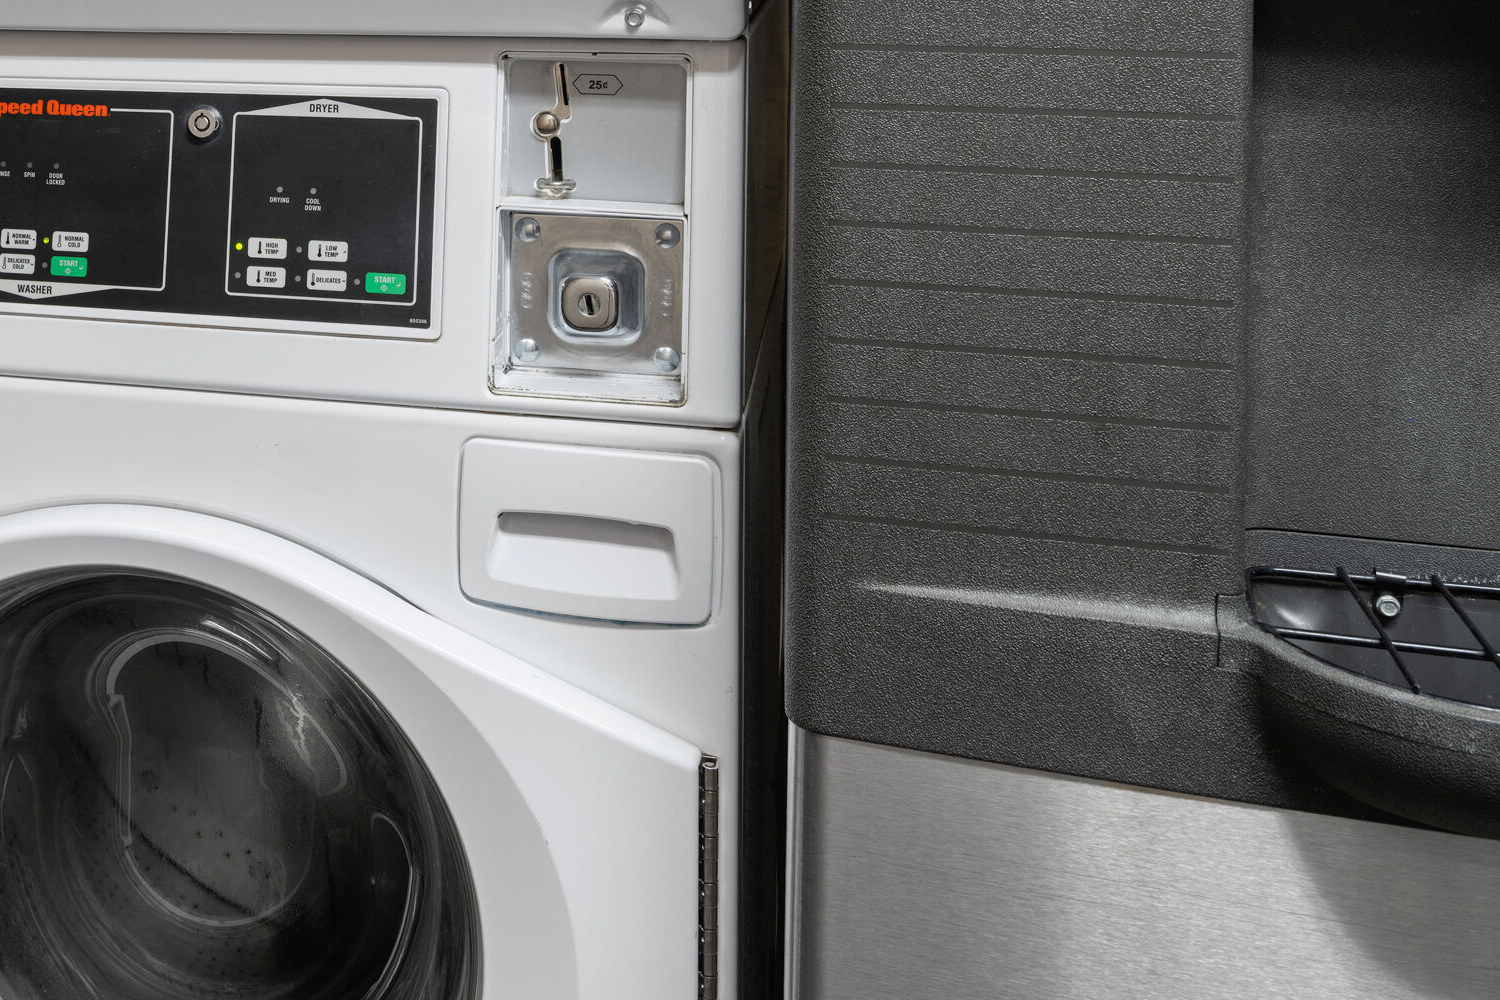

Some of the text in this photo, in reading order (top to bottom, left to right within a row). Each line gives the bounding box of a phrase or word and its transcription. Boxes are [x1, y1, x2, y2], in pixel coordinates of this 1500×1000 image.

[588, 80, 608, 90] 25¢
[46, 99, 108, 117] Queen
[309, 103, 340, 114] DRYER
[269, 196, 290, 204] DRYING
[7, 257, 31, 265] DELICATES
[59, 259, 79, 267] START
[374, 276, 396, 284] START
[17, 284, 53, 295] WASHER
